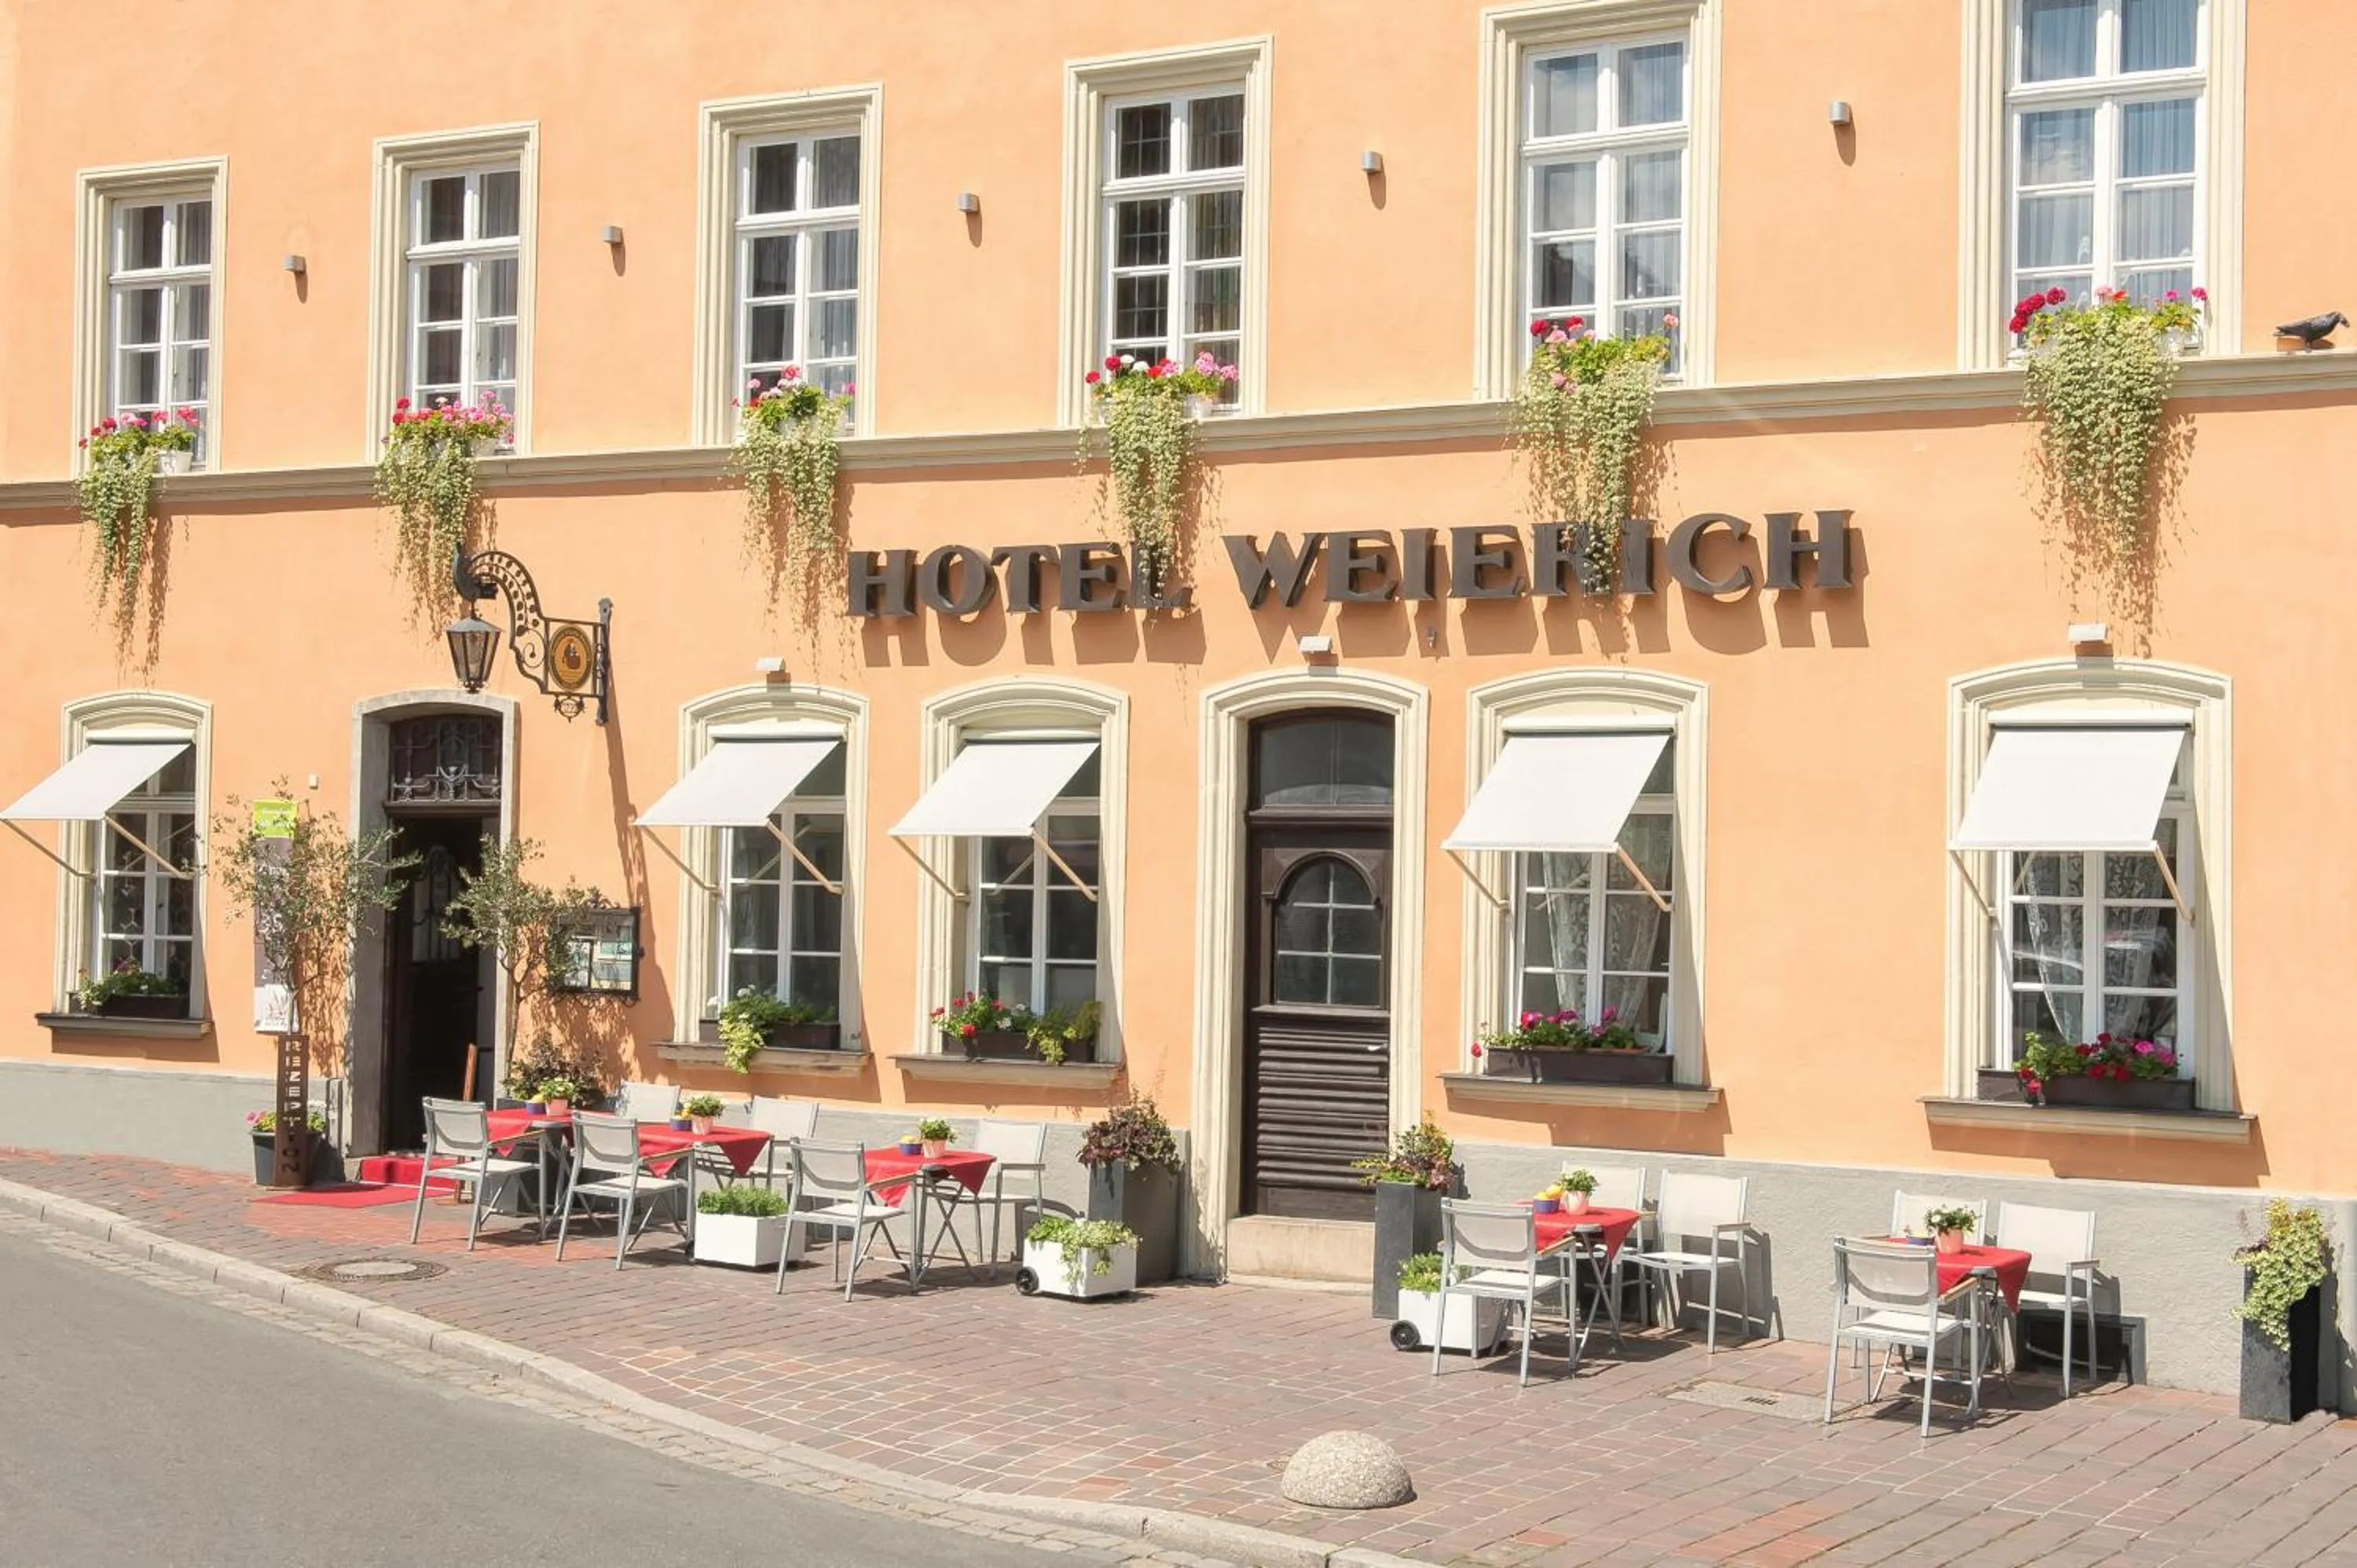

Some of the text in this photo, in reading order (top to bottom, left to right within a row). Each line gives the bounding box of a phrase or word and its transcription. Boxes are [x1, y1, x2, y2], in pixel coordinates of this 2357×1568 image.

[847, 510, 1852, 617] HOTEL WEIERICH
[281, 1040, 302, 1172] REZEPTION
